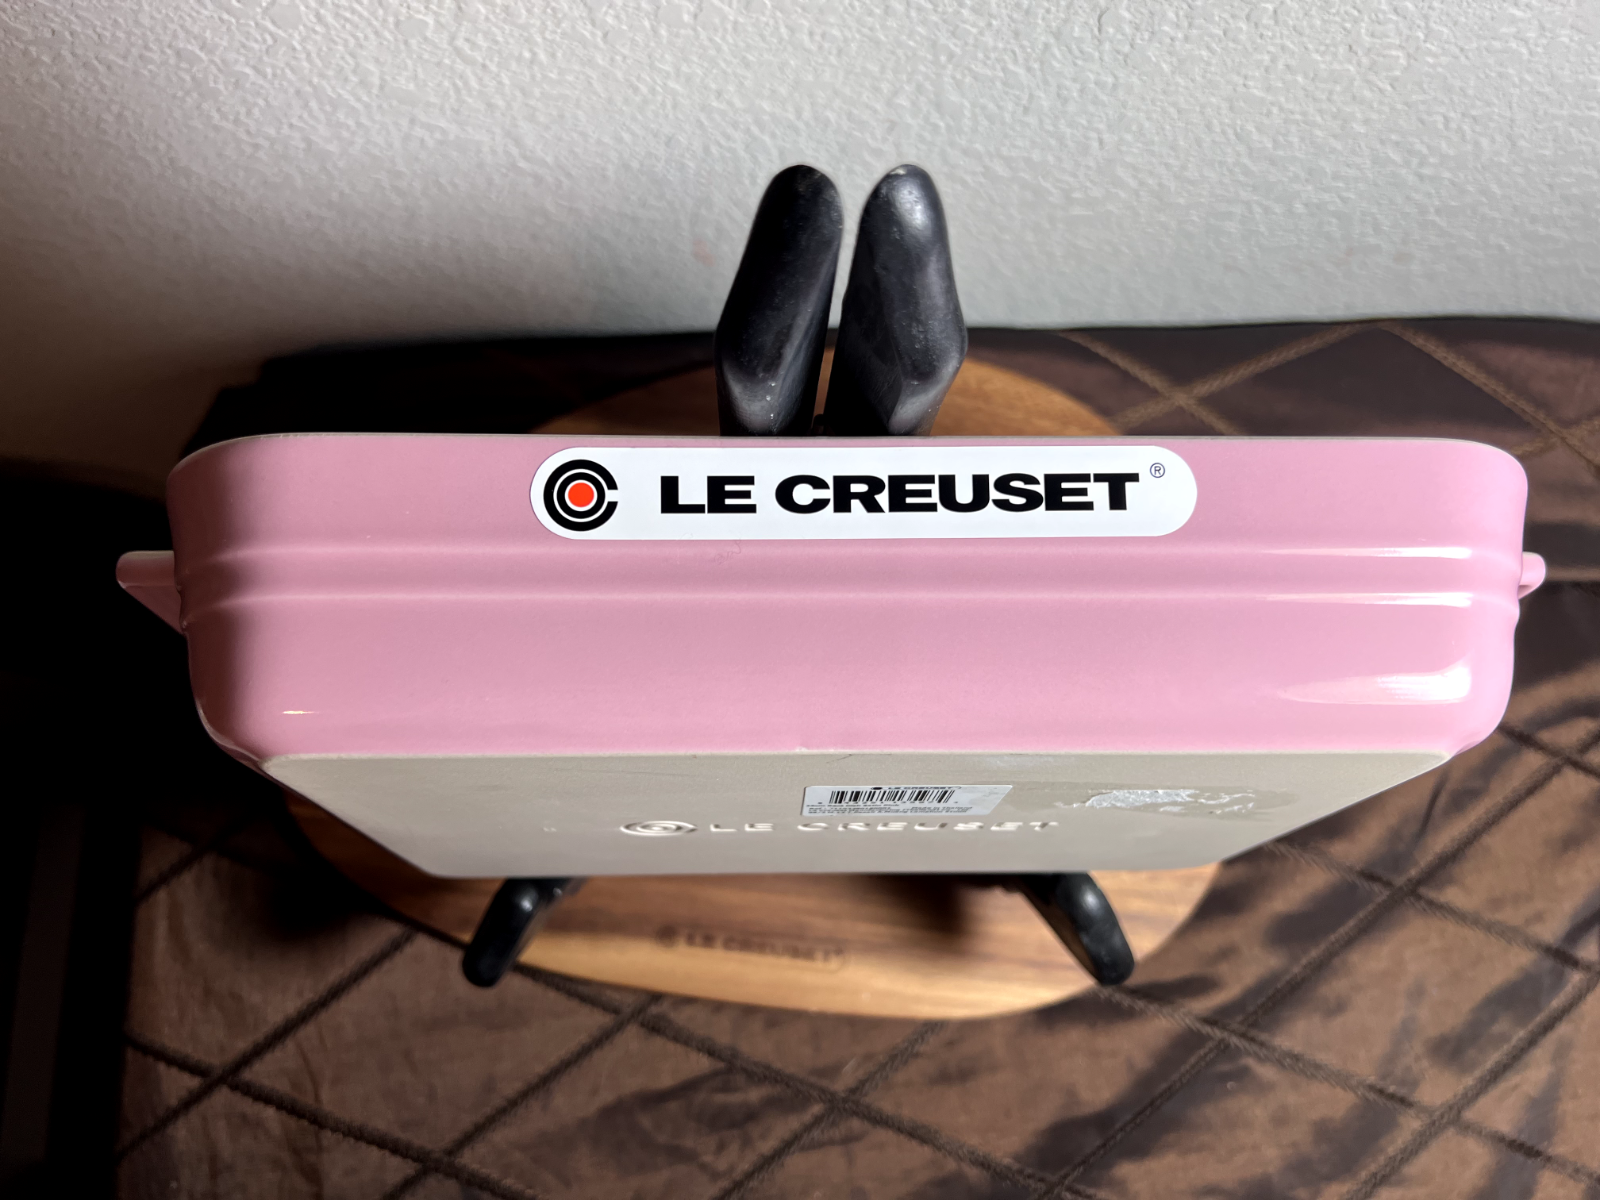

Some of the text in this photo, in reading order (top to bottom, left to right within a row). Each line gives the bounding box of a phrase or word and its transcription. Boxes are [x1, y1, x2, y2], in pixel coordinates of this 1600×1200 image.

[661, 475, 756, 514] LE
[775, 472, 1139, 515] CREUSET
[709, 821, 1058, 833] LE CREUSET
